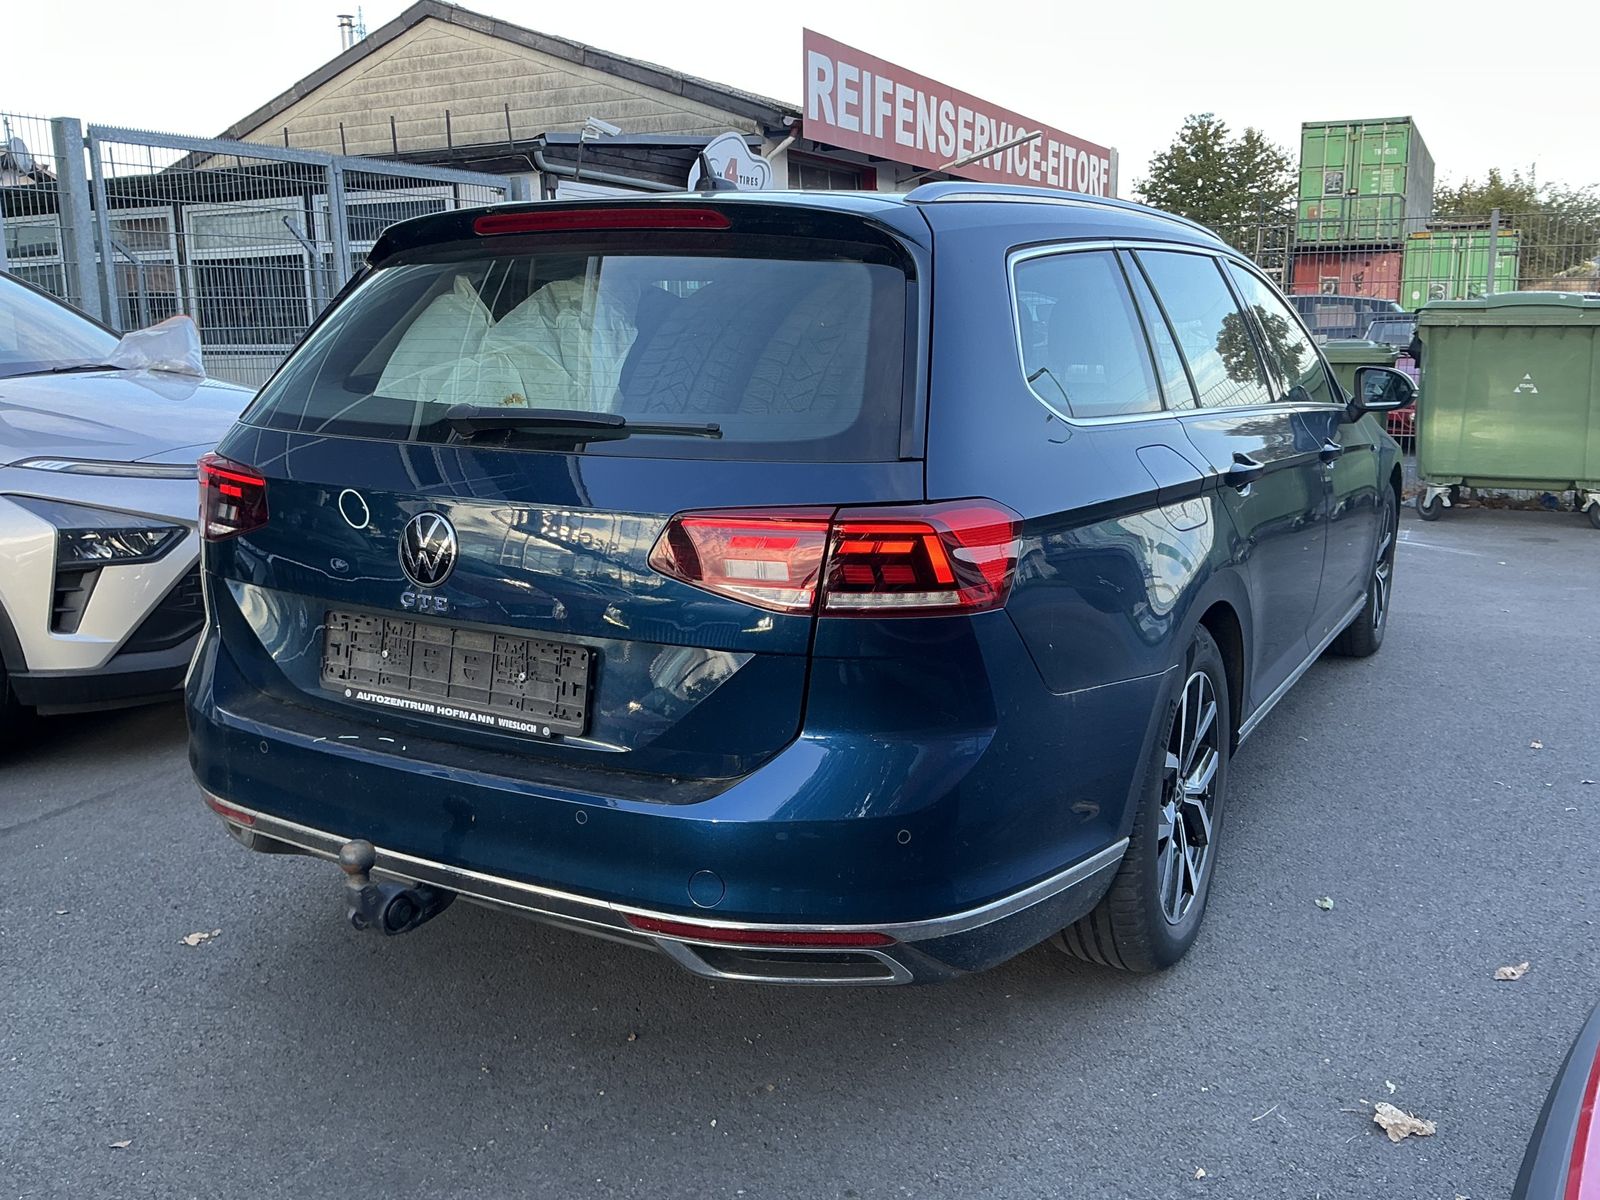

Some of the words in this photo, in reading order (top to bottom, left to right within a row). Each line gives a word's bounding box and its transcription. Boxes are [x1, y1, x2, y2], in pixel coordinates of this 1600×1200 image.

[807, 50, 1109, 197] REIFENSERVICE-EITORF
[724, 157, 739, 184] 4
[739, 174, 759, 187] TIRES
[401, 512, 456, 585] VW
[400, 591, 448, 612] GTE
[356, 690, 435, 714] AUTOZENTRUM
[436, 705, 495, 726] HOFMANN
[498, 716, 538, 734] WIESLOCH
